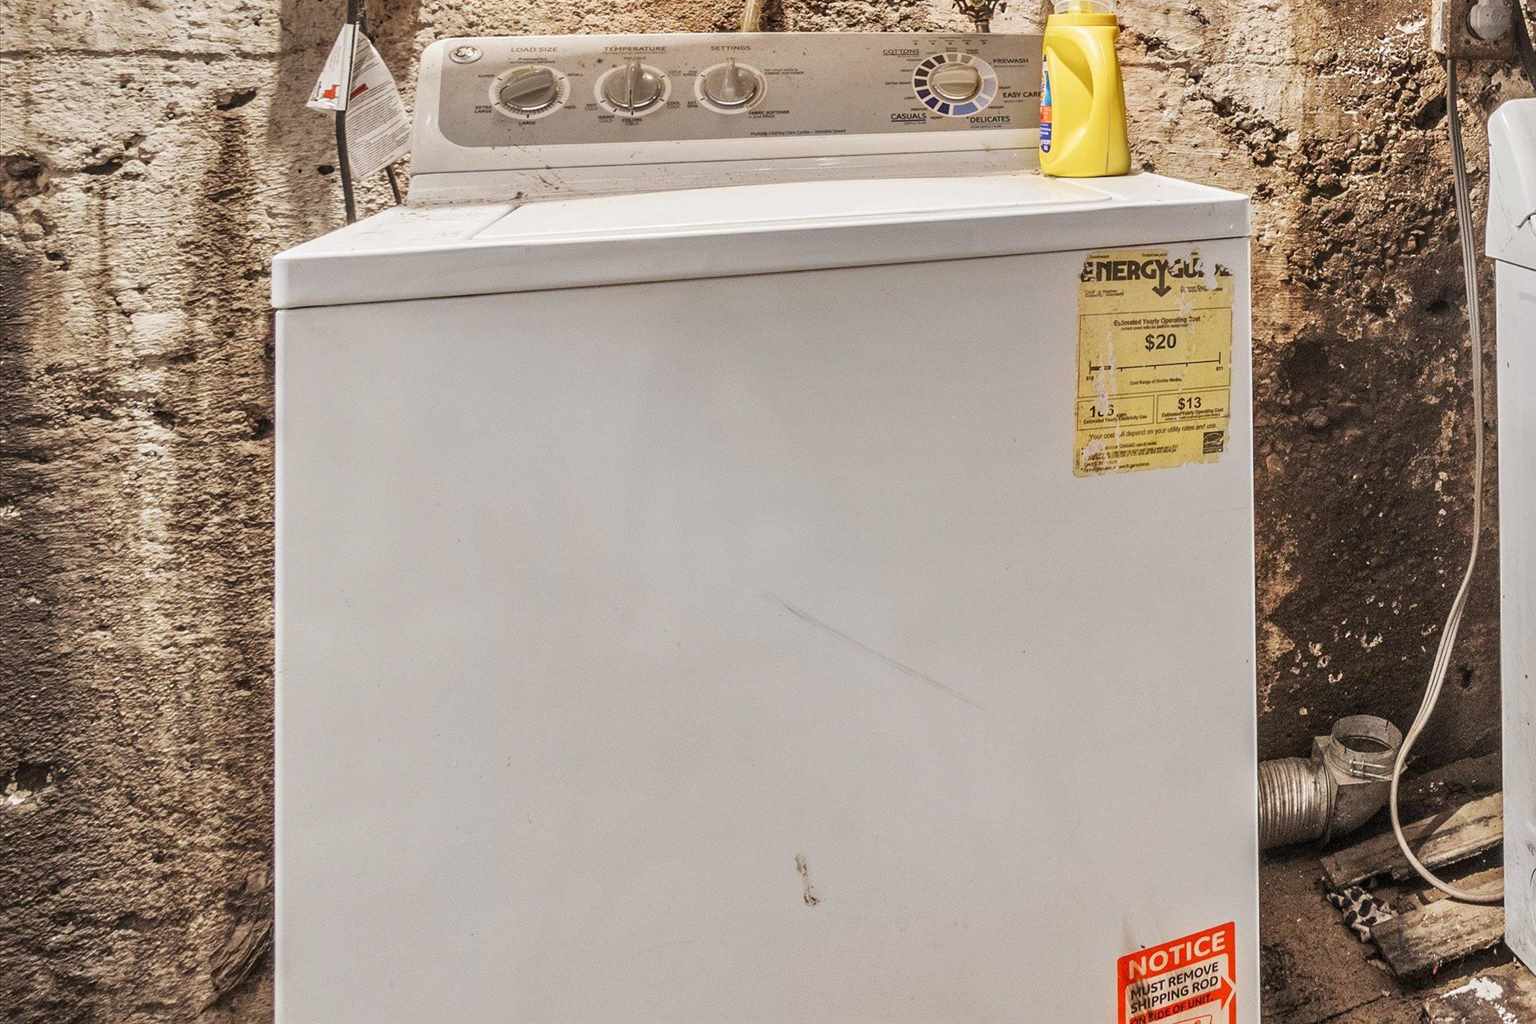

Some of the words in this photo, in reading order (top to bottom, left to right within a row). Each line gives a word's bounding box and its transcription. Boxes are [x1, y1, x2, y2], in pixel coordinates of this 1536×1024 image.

[890, 112, 927, 120] CASUALS
[1144, 332, 1177, 352] $20
[1178, 396, 1202, 410] $13
[1128, 930, 1226, 980] NOTICE
[1130, 980, 1166, 1000] MUST
[1168, 962, 1219, 988] REMOVE
[1130, 987, 1189, 1014] SHIPPING
[1192, 976, 1218, 994] ROD
[1148, 1008, 1172, 1022] SIDE
[1172, 1004, 1185, 1014] OF
[1189, 994, 1214, 1009] UNIT.
